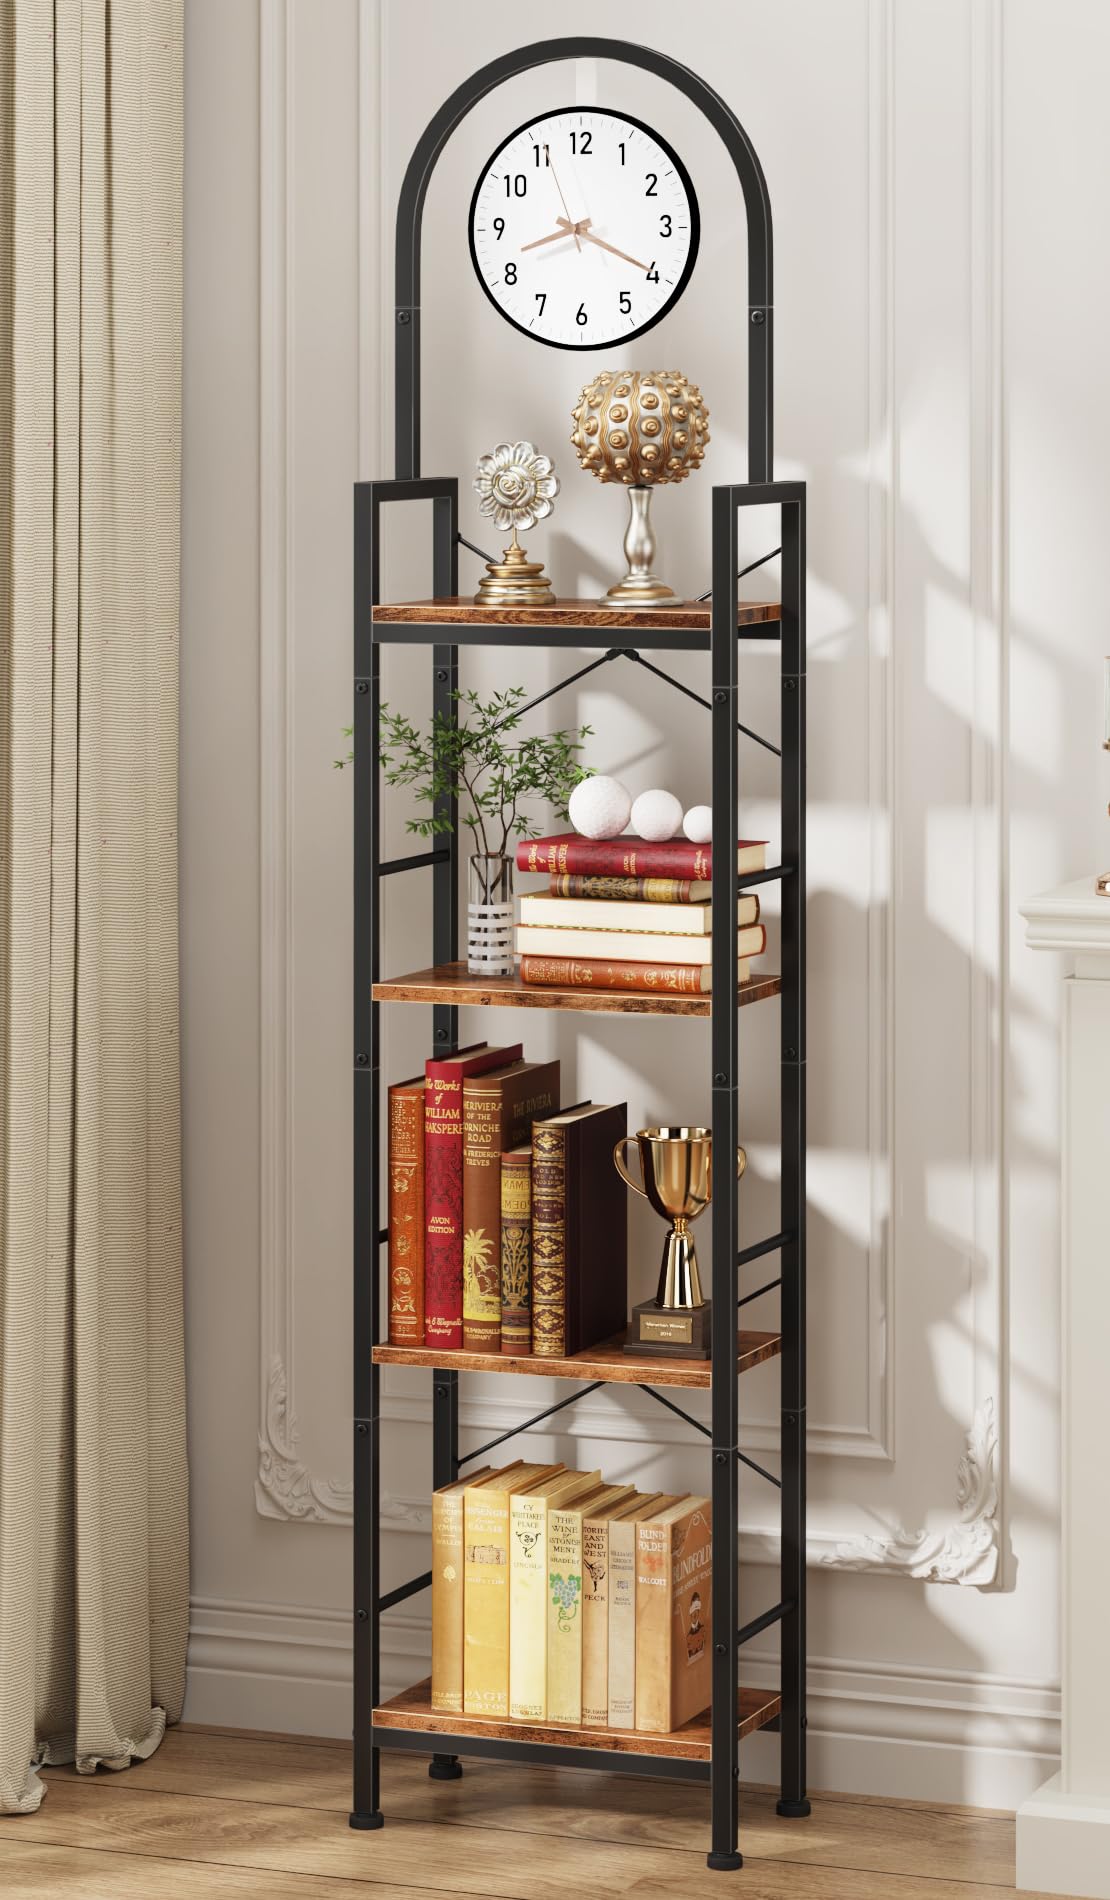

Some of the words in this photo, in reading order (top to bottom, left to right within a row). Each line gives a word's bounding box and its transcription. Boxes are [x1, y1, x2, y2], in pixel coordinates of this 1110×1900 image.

[570, 131, 593, 155] 12
[533, 144, 550, 168] 11
[618, 142, 625, 166] 1
[503, 174, 527, 198] 10
[645, 173, 658, 197] 2
[493, 217, 505, 241] 9
[659, 214, 672, 238] 3
[504, 262, 518, 286] 8
[646, 261, 660, 284] 4
[535, 293, 547, 317] 7
[619, 291, 632, 315] 5
[576, 302, 588, 326] 6
[434, 1079, 461, 1091] Works
[434, 1092, 444, 1105] of
[425, 1106, 460, 1120] WILLIAM
[468, 1133, 492, 1142] ROAD
[466, 1158, 490, 1166] TREVES
[430, 1216, 451, 1224] AVON
[428, 1226, 455, 1234] EDITION
[428, 1324, 452, 1336] Company
[524, 1504, 534, 1512] CY
[518, 1520, 539, 1529] PLACE
[556, 1516, 576, 1525] THE
[552, 1525, 578, 1534] WINE
[584, 1534, 606, 1542] EAST
[554, 1546, 576, 1554] MENT
[584, 1542, 604, 1550] AND
[584, 1594, 606, 1602] PECK
[464, 1688, 506, 1700] PAGE
